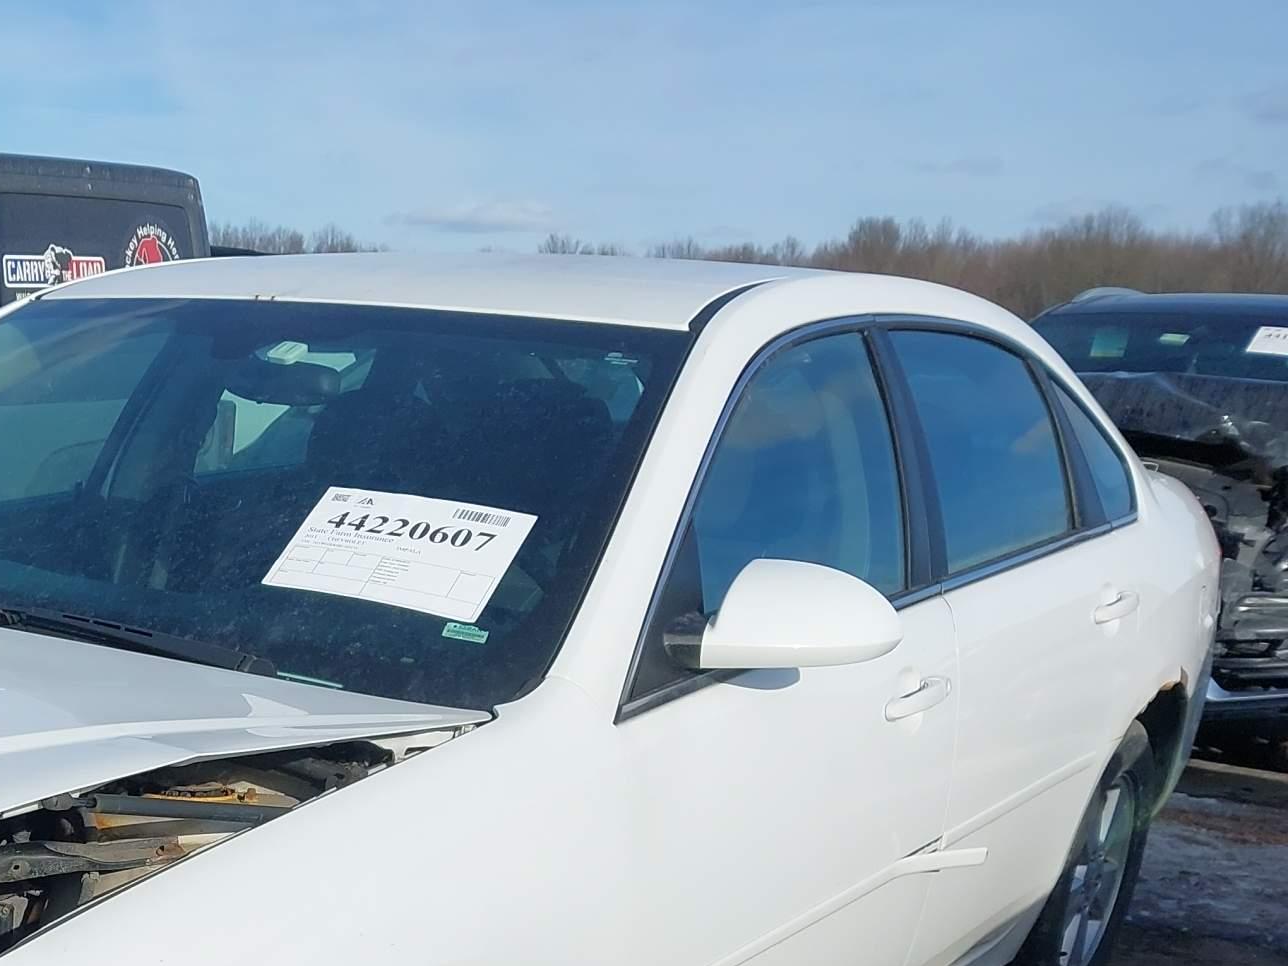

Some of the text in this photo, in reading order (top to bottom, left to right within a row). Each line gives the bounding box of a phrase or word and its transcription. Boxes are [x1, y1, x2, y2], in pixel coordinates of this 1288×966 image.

[137, 222, 168, 243] Helping
[7, 260, 45, 282] CARRY
[308, 526, 329, 534] State
[330, 529, 352, 537] Farm
[327, 511, 498, 551] 44220607
